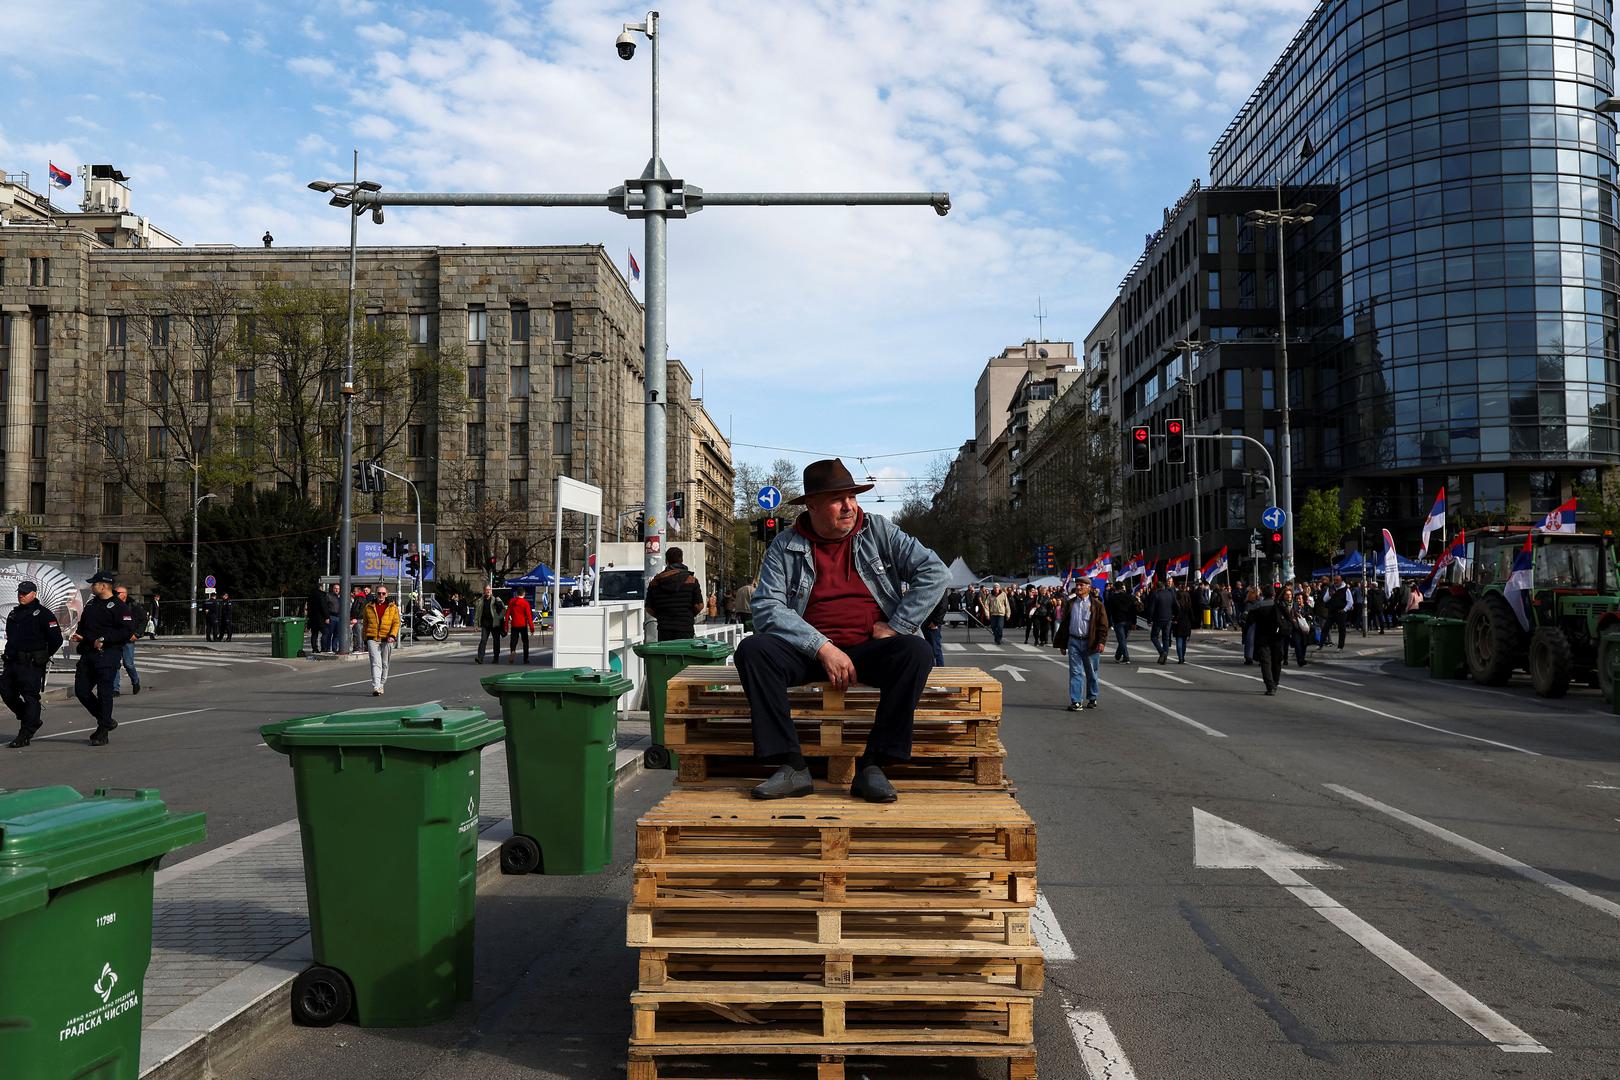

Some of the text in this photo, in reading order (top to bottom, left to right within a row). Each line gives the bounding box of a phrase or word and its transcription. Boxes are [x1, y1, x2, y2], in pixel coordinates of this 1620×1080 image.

[96, 912, 116, 927] 117981
[60, 995, 139, 1041] ГРАДСКА ЧИСТОЋА
